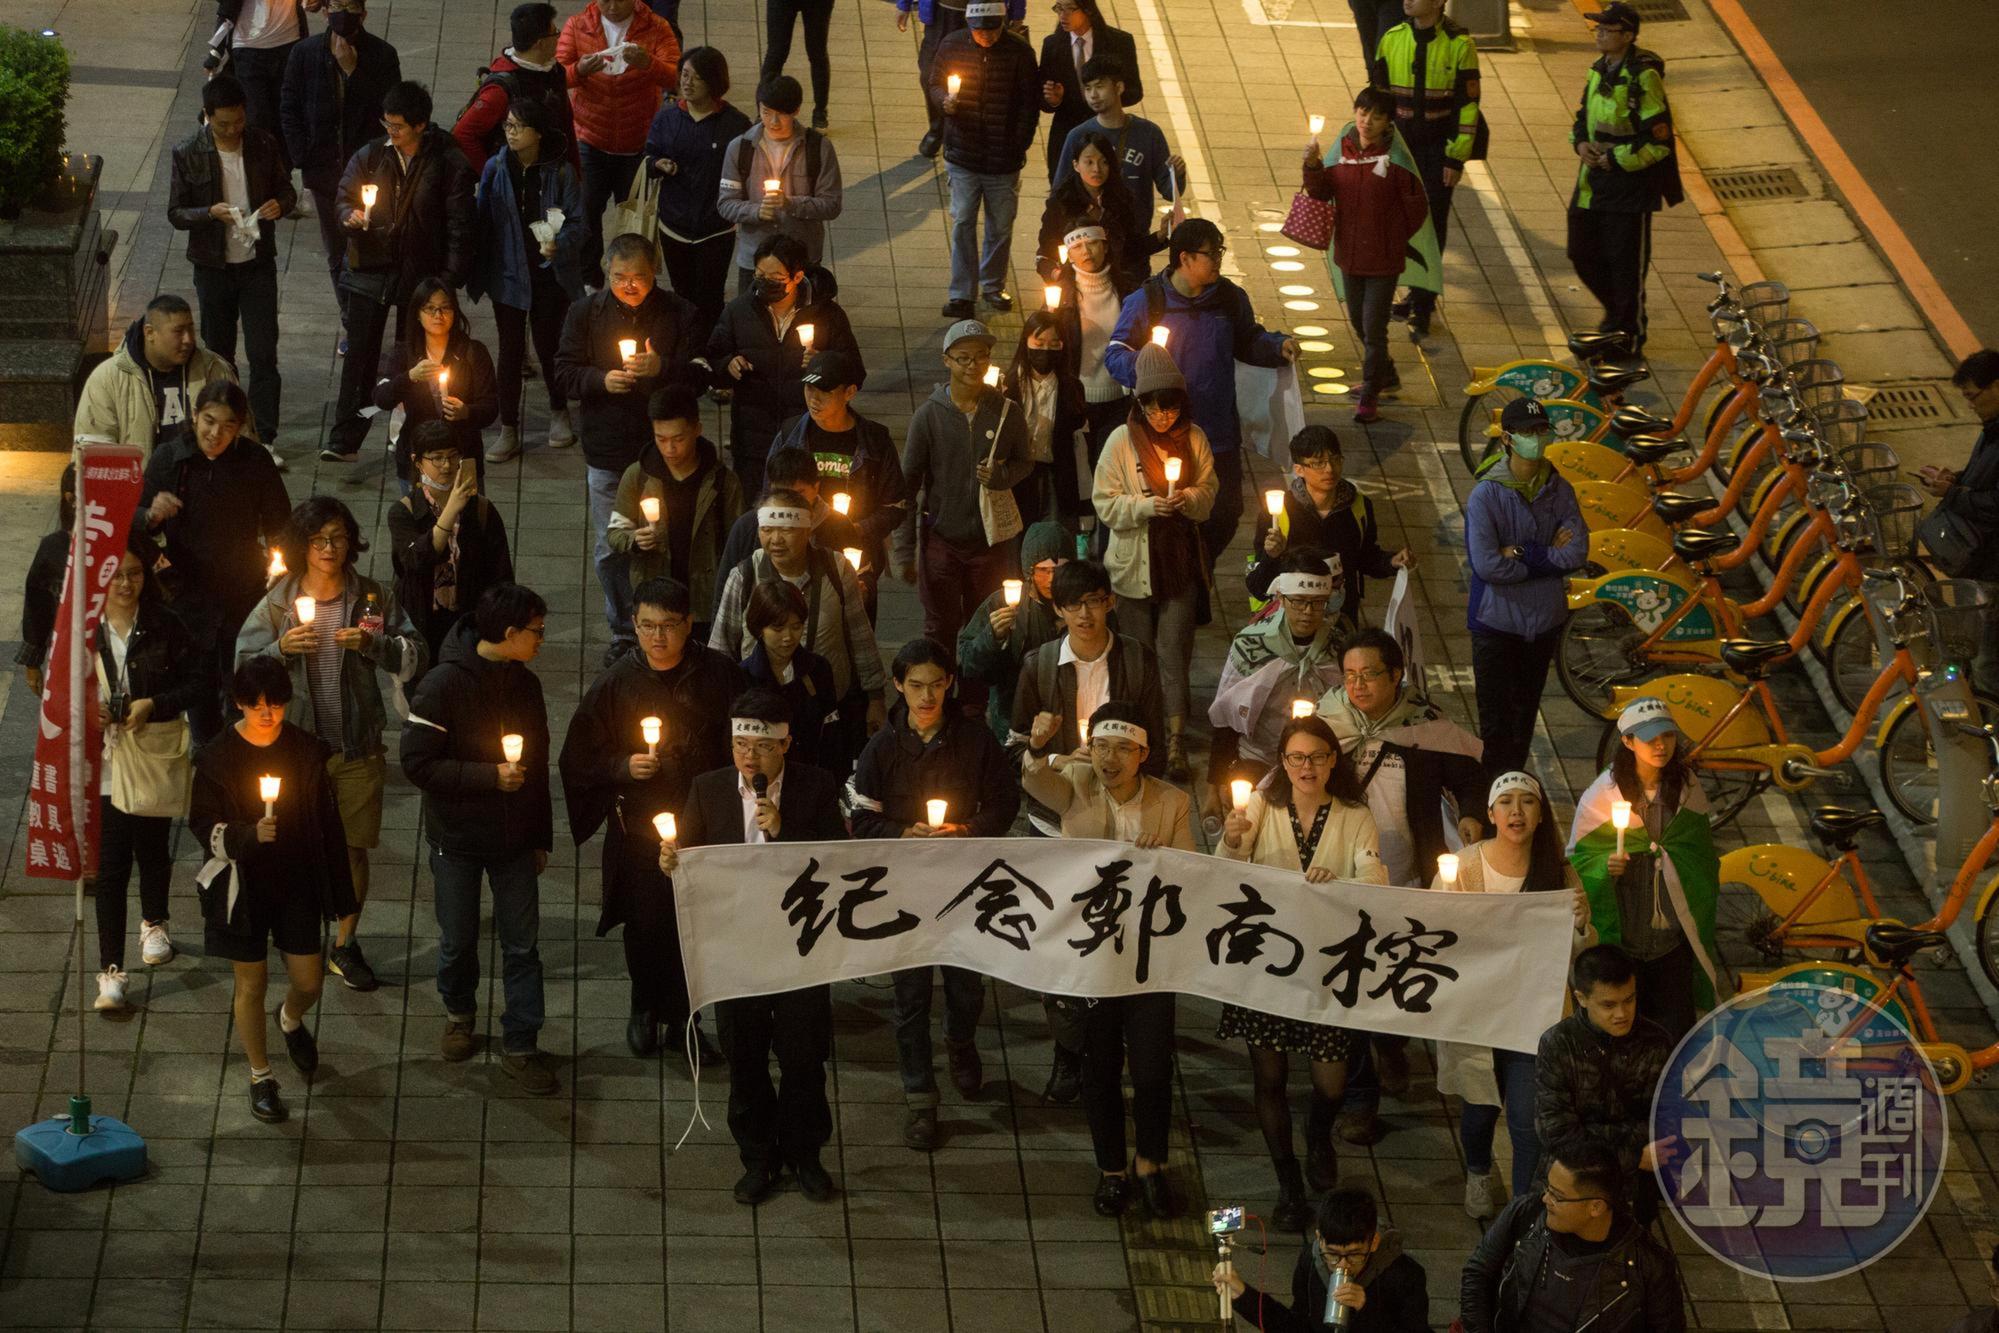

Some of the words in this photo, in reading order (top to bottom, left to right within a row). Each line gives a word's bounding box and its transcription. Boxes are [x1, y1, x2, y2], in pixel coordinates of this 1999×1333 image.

[1526, 402, 1540, 415] NY
[769, 512, 801, 521] 建國時代
[1297, 580, 1328, 590] 建國時代
[736, 722, 769, 735] 建國時代
[1102, 723, 1136, 737] 建國時代
[781, 857, 1460, 1014] 紀念鄭南榕
